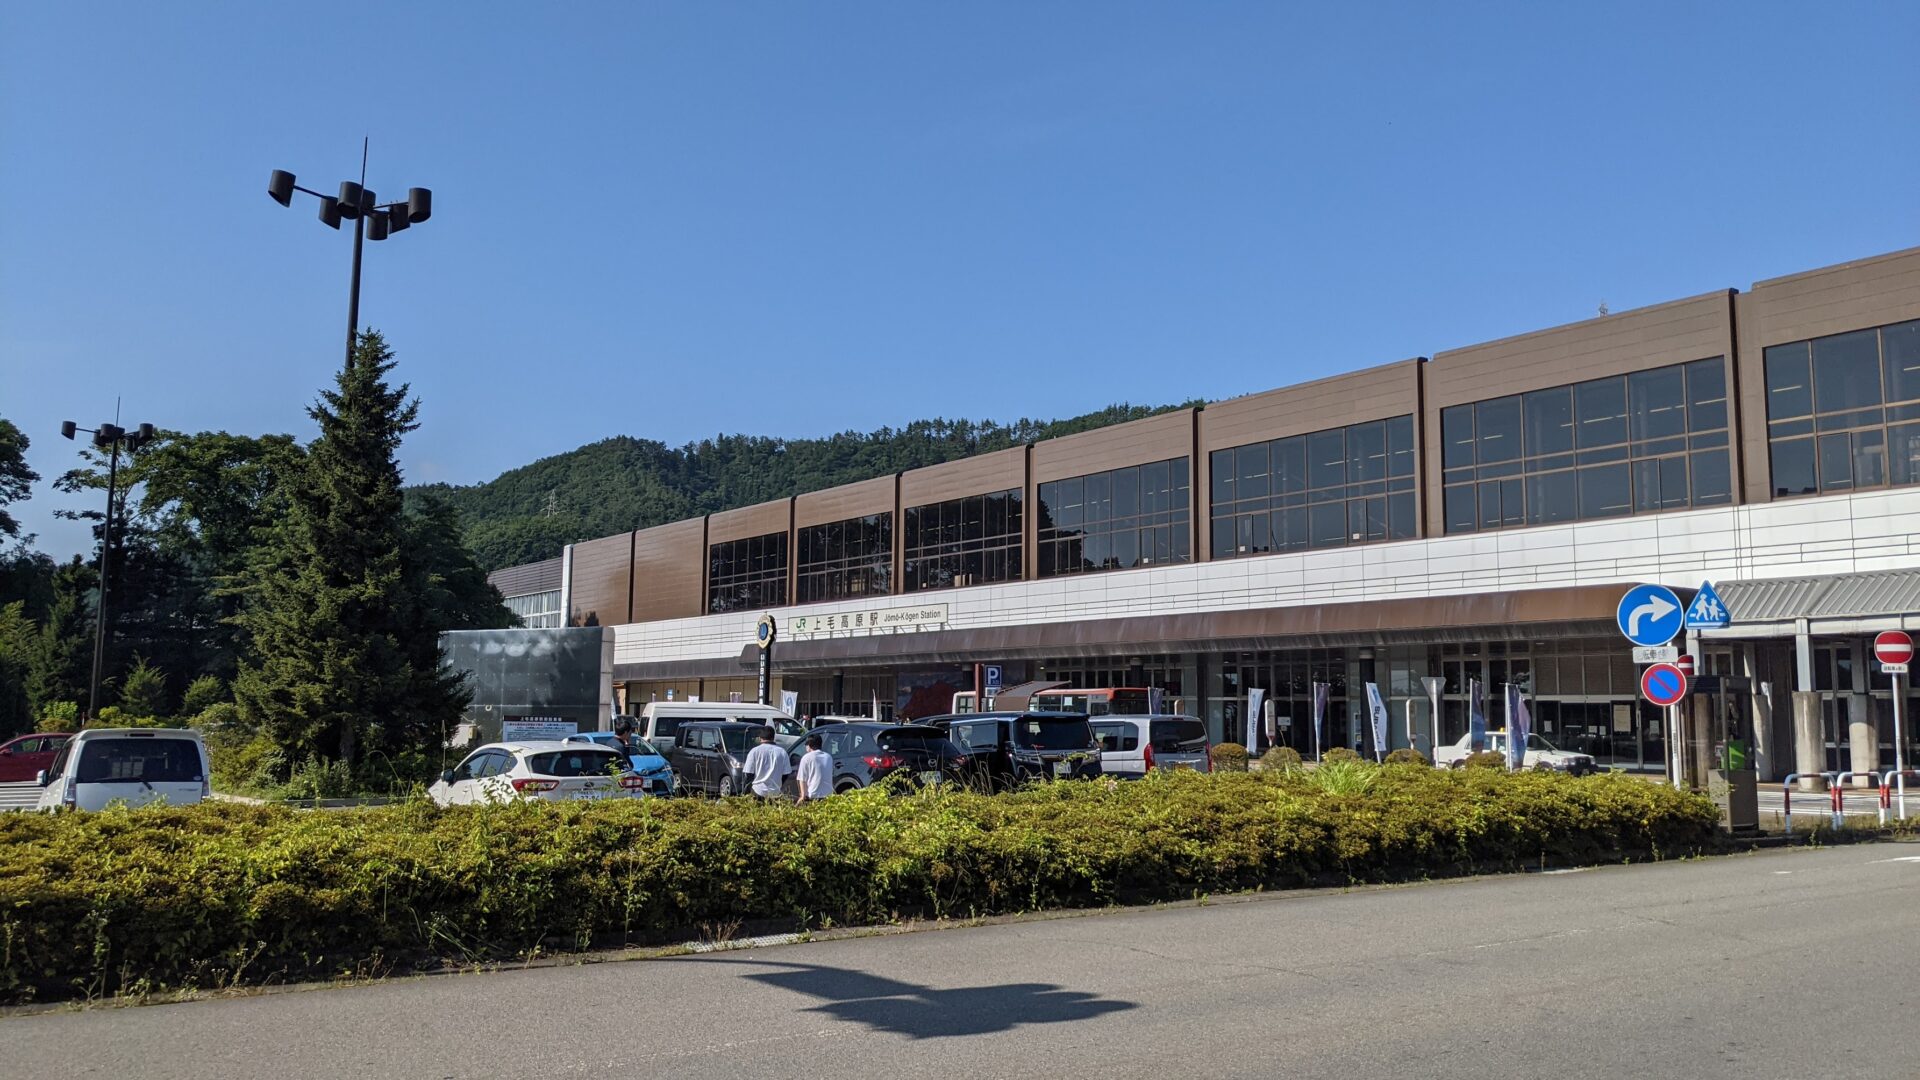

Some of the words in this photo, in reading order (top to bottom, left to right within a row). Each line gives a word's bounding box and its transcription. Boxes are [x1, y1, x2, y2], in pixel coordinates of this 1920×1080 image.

[814, 612, 878, 630] 上毛高原駅
[920, 610, 941, 619] Station
[796, 618, 806, 628] JR
[988, 668, 999, 684] P
